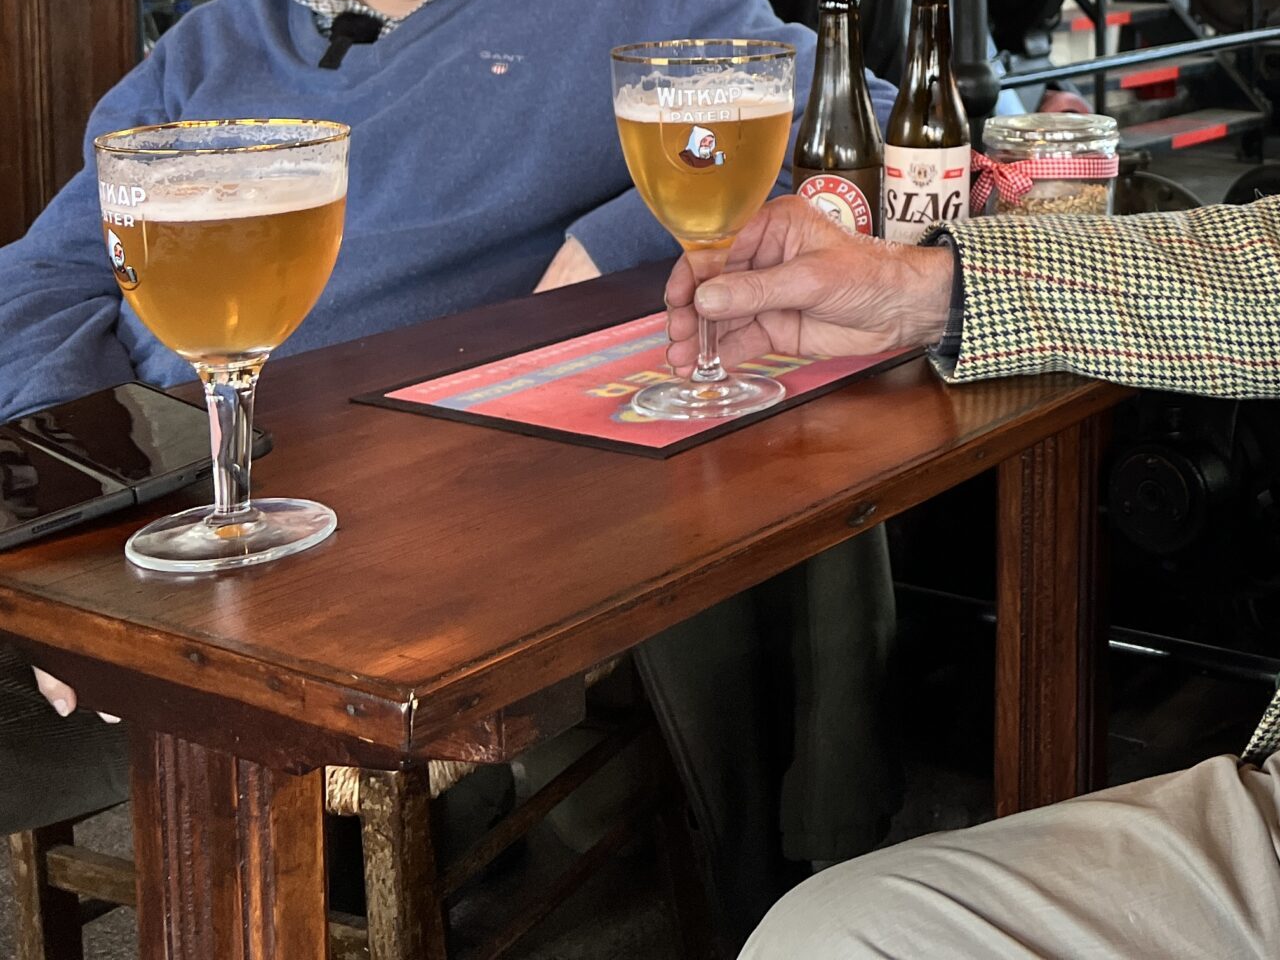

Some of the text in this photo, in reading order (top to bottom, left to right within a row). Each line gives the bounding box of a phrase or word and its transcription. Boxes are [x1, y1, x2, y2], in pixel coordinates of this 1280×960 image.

[656, 87, 742, 107] WITKAP
[671, 110, 731, 122] PATER
[836, 184, 868, 226] PATER
[886, 189, 963, 224] SLAG
